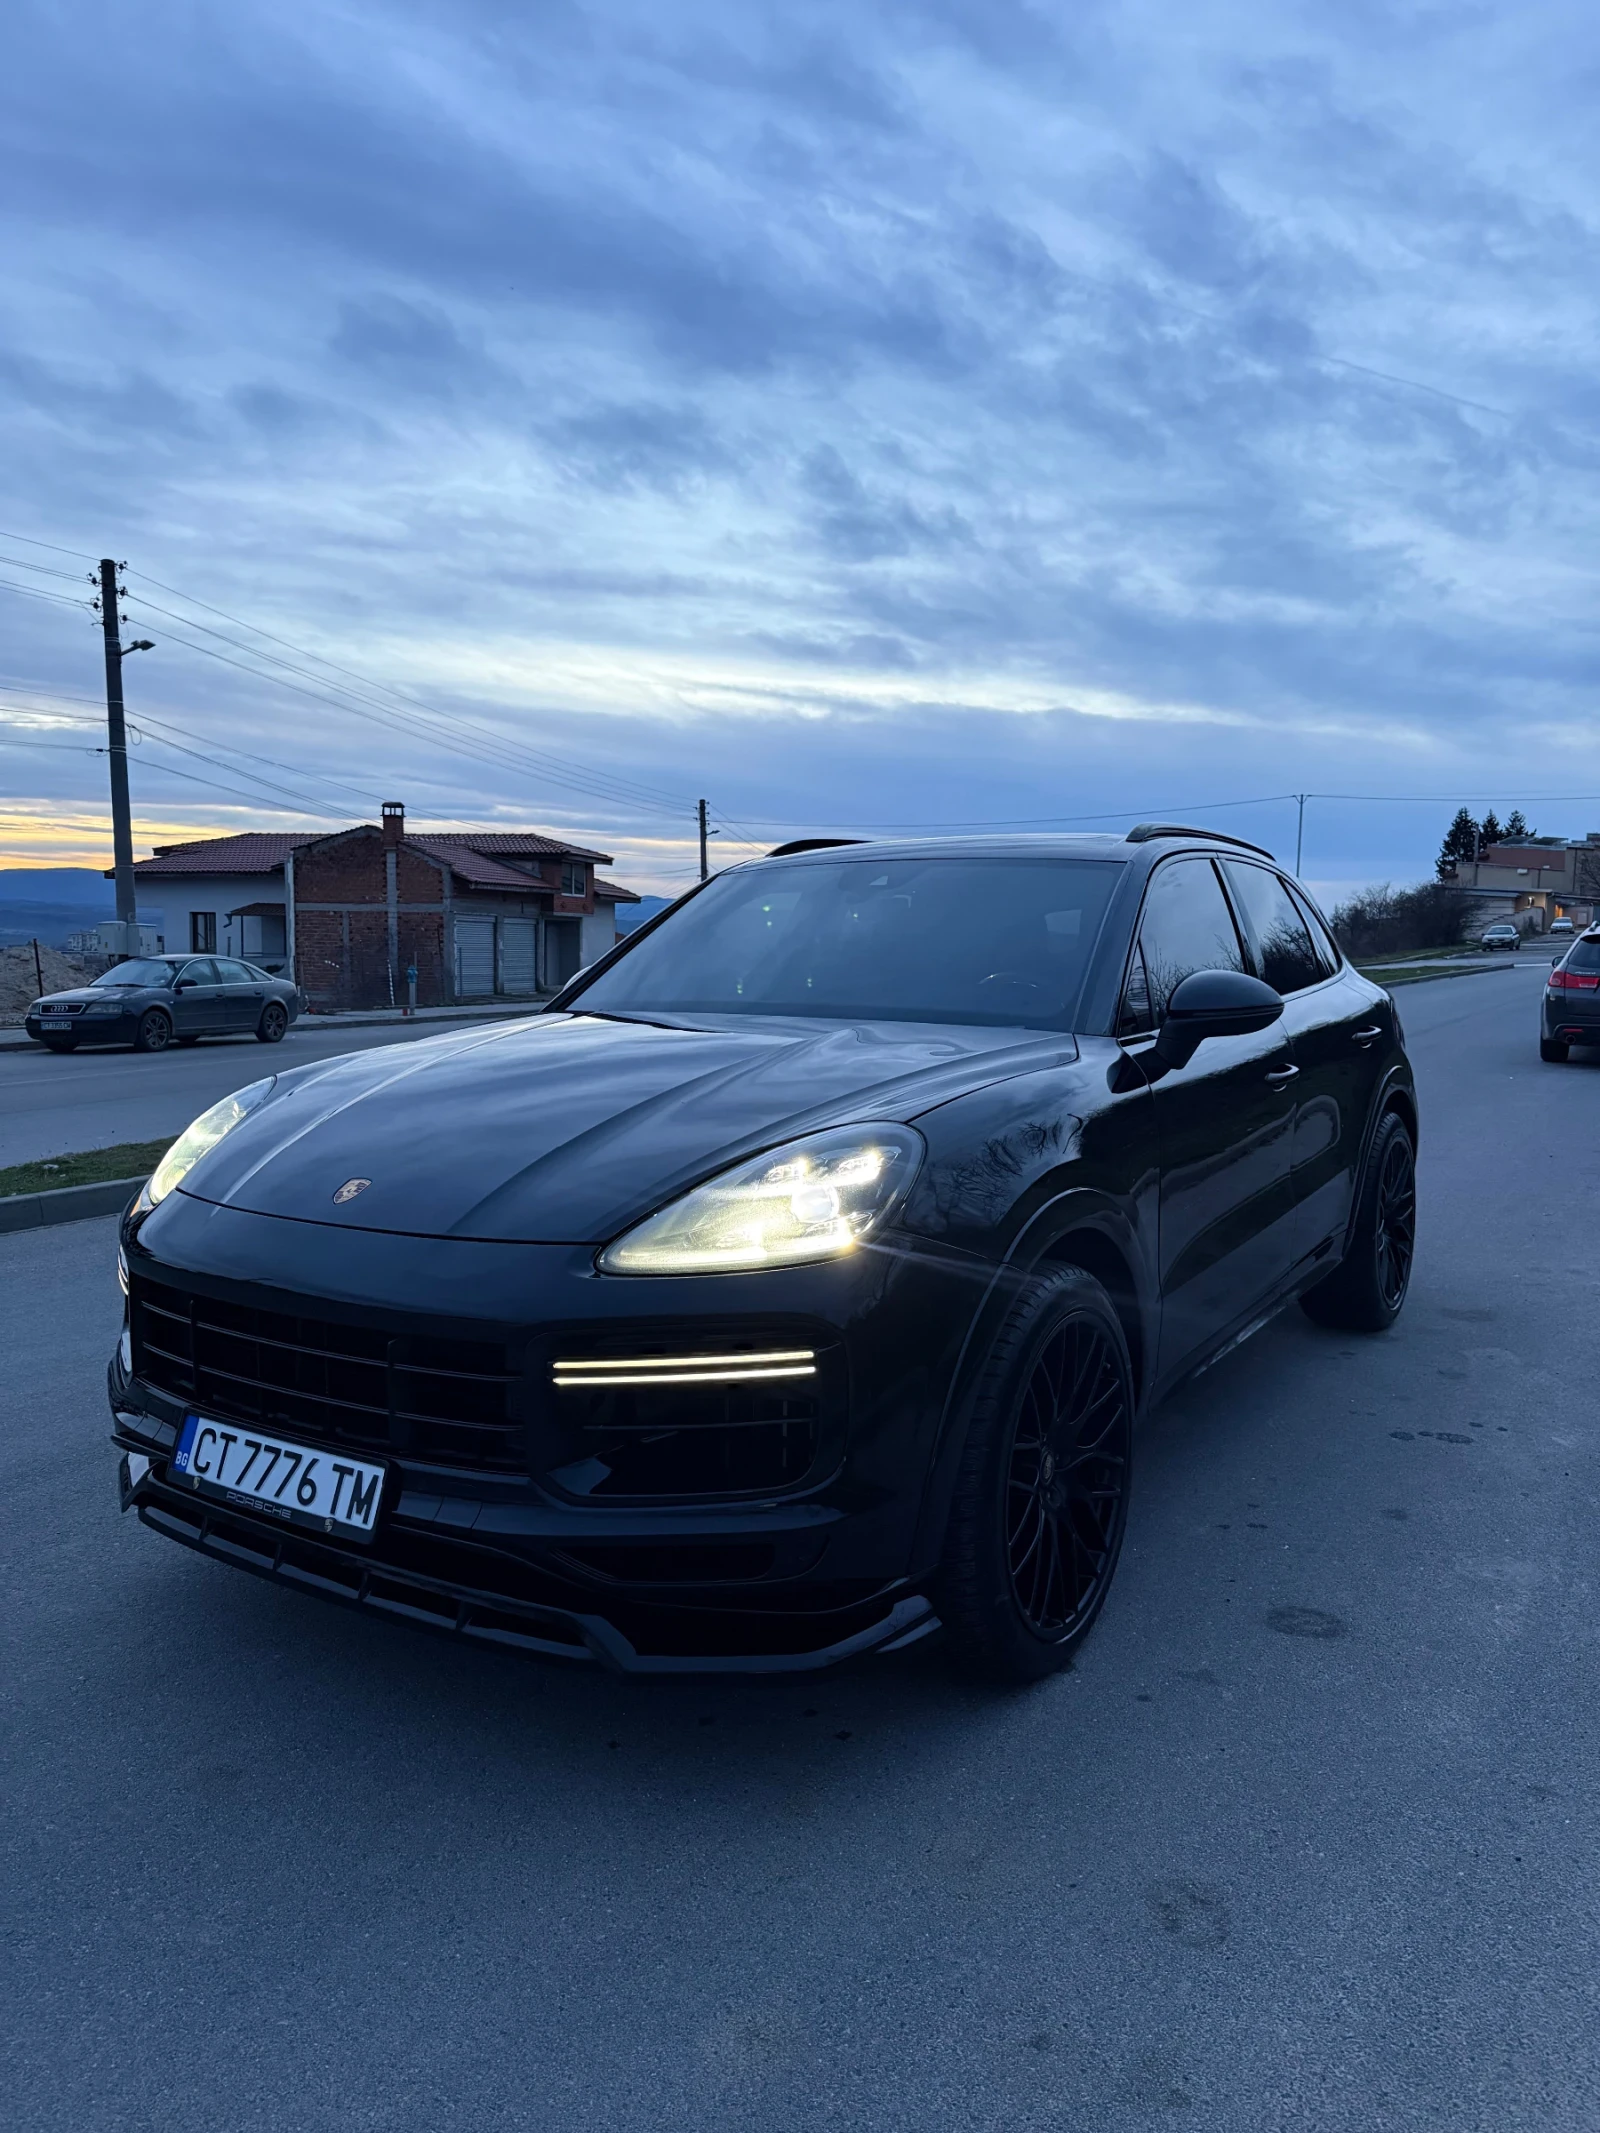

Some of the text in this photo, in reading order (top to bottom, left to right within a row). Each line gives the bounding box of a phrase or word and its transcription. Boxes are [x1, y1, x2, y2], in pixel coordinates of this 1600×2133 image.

[175, 1451, 189, 1467] BG
[226, 1490, 292, 1519] PORSCHE
[329, 1463, 380, 1525] TM
